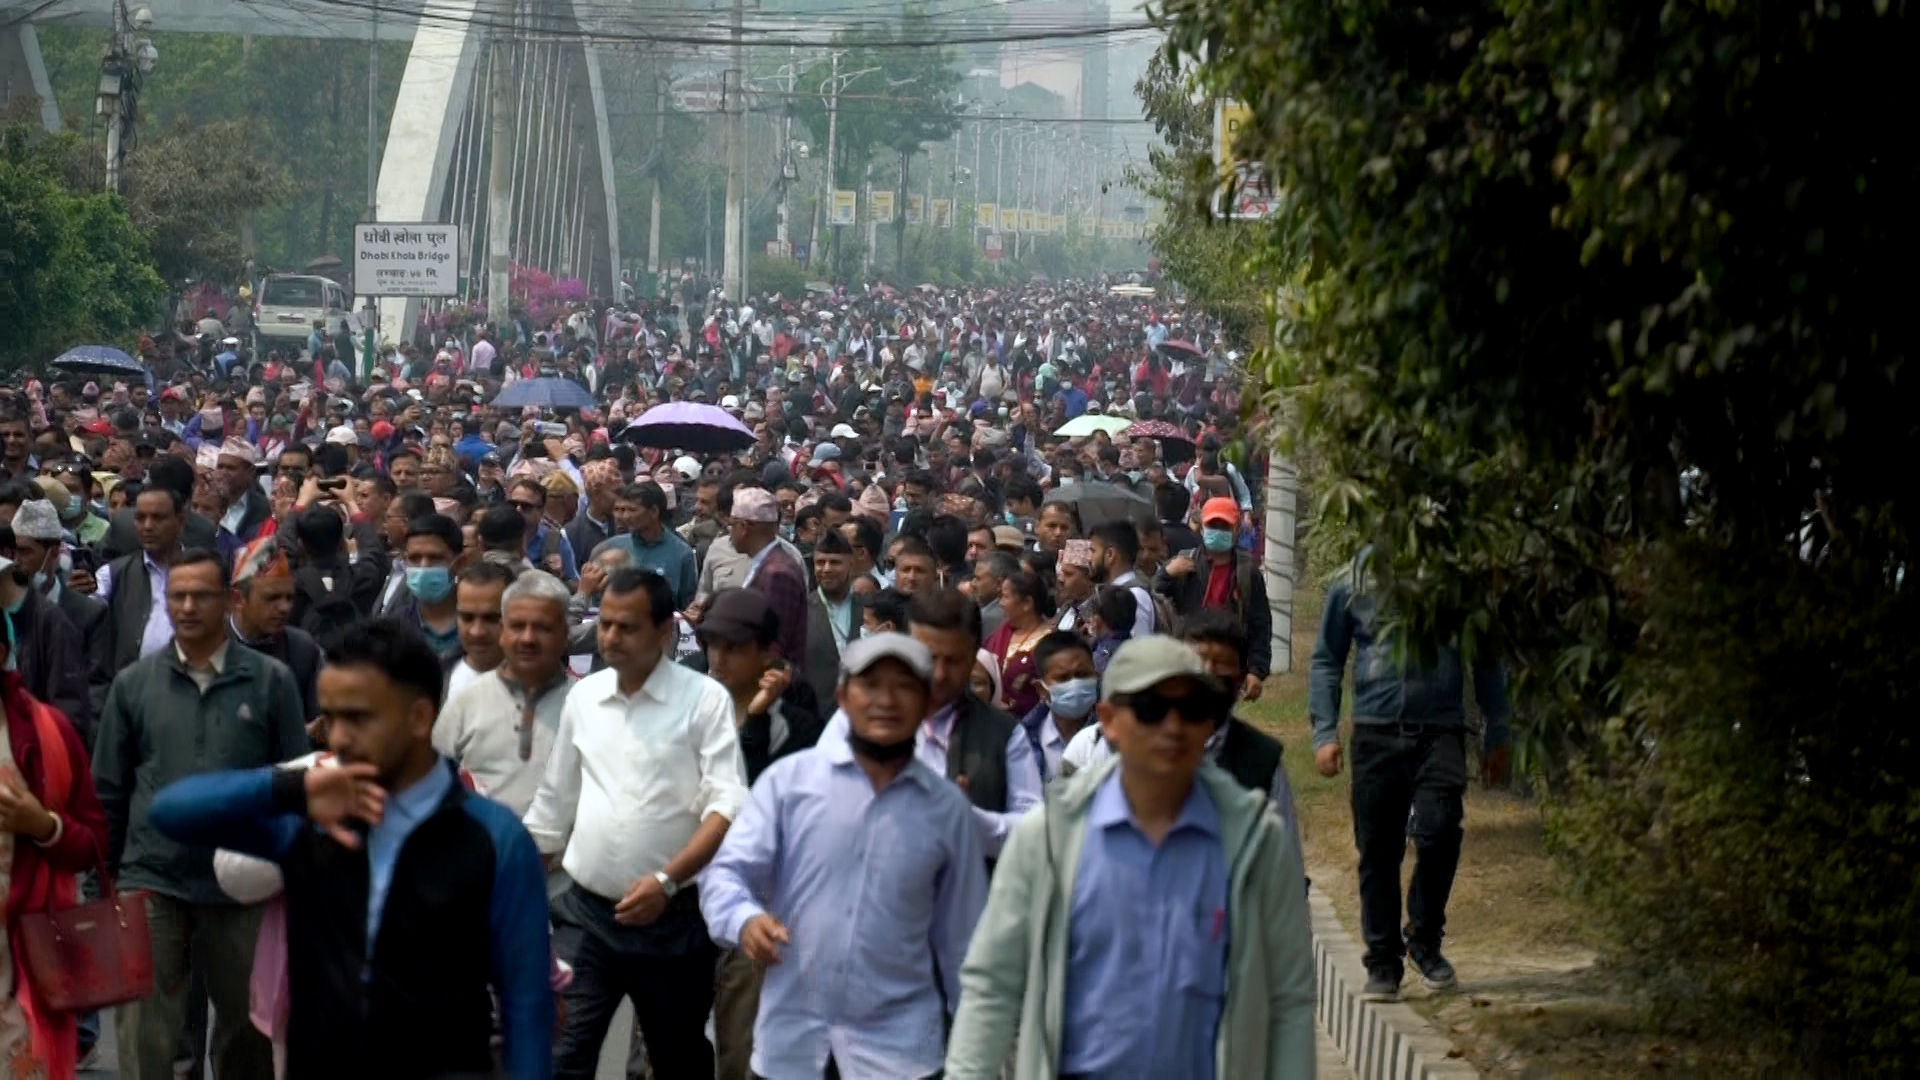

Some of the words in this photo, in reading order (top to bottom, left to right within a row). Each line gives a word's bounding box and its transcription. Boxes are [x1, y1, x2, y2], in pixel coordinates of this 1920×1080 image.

[393, 227, 423, 245] खोला
[426, 231, 448, 247] पुल
[360, 251, 389, 260] Dhobi
[391, 251, 416, 260] Khola
[418, 251, 450, 263] Bridge
